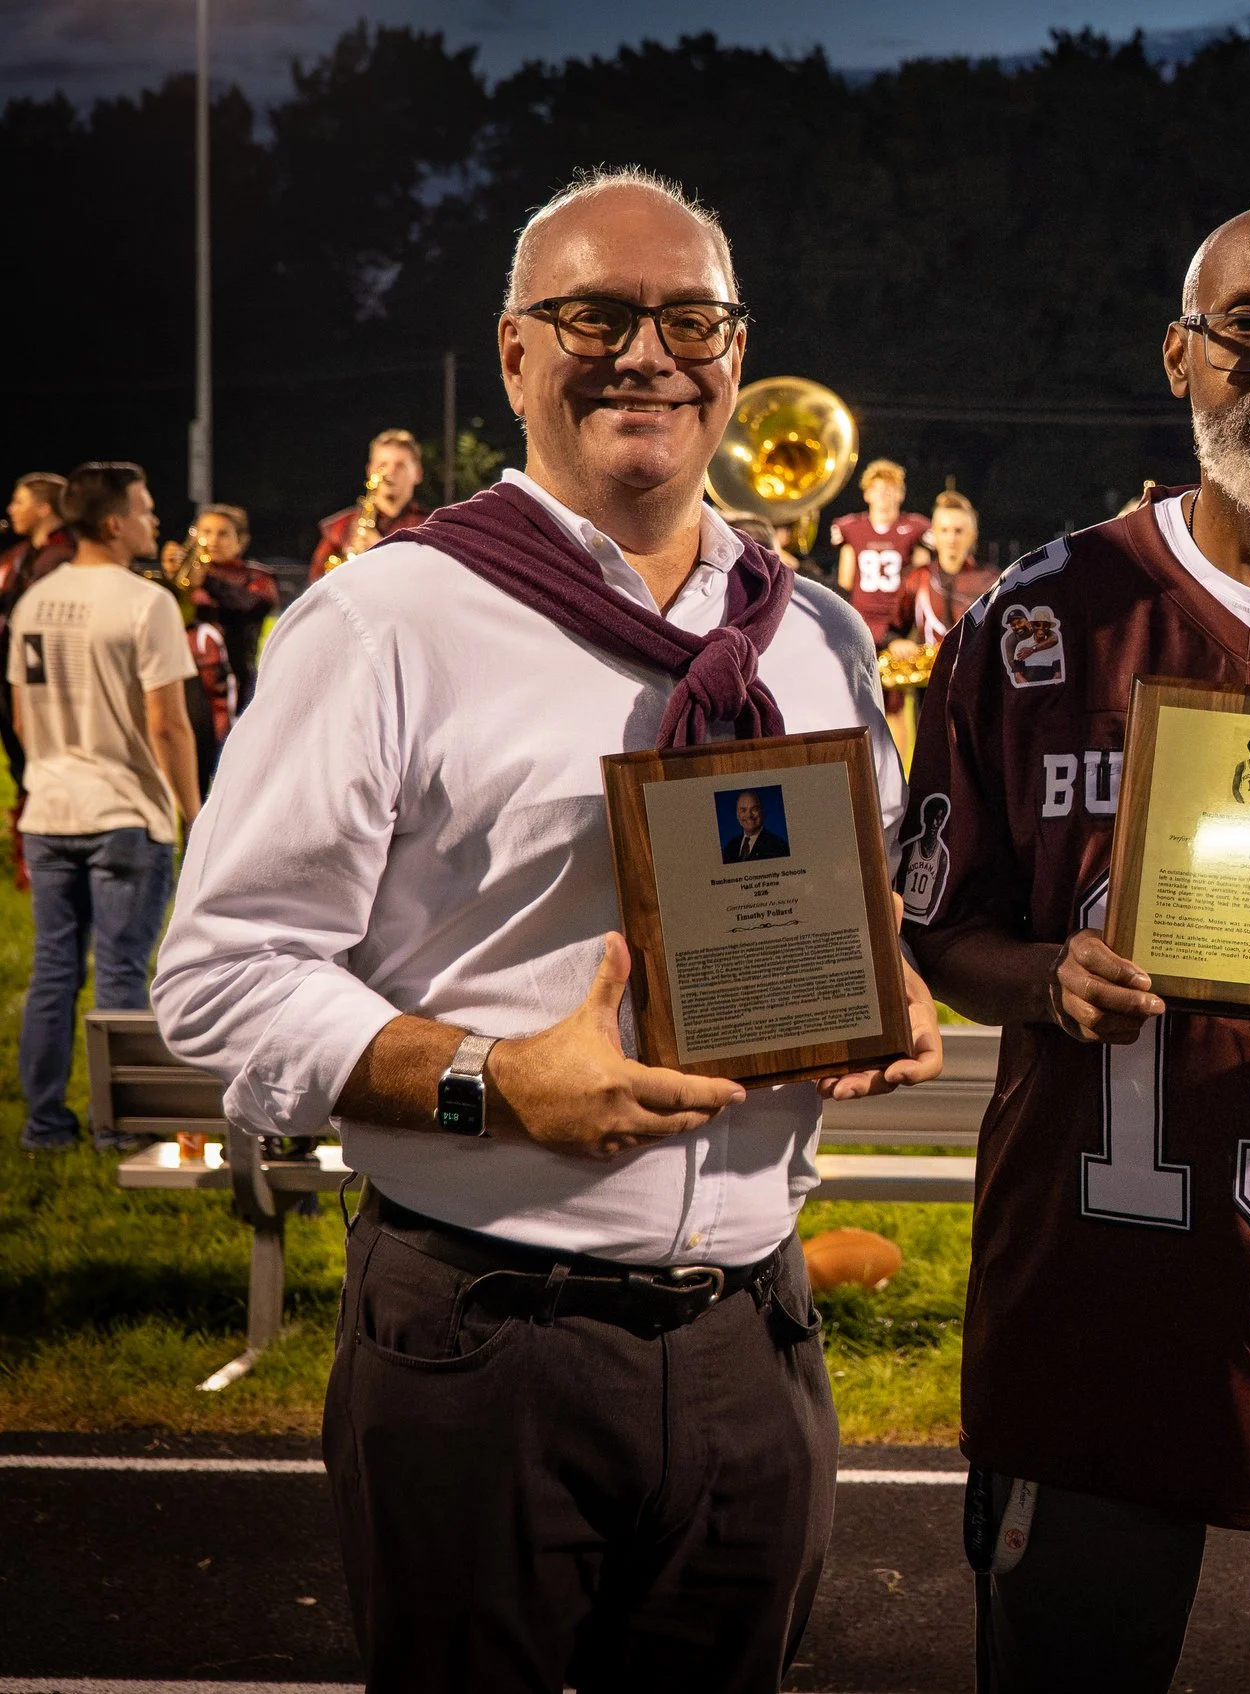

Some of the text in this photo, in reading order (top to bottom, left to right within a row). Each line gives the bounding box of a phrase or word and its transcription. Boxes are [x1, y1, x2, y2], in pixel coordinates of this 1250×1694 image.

[910, 872, 928, 895] 10
[736, 908, 793, 922] Timothy Pollard
